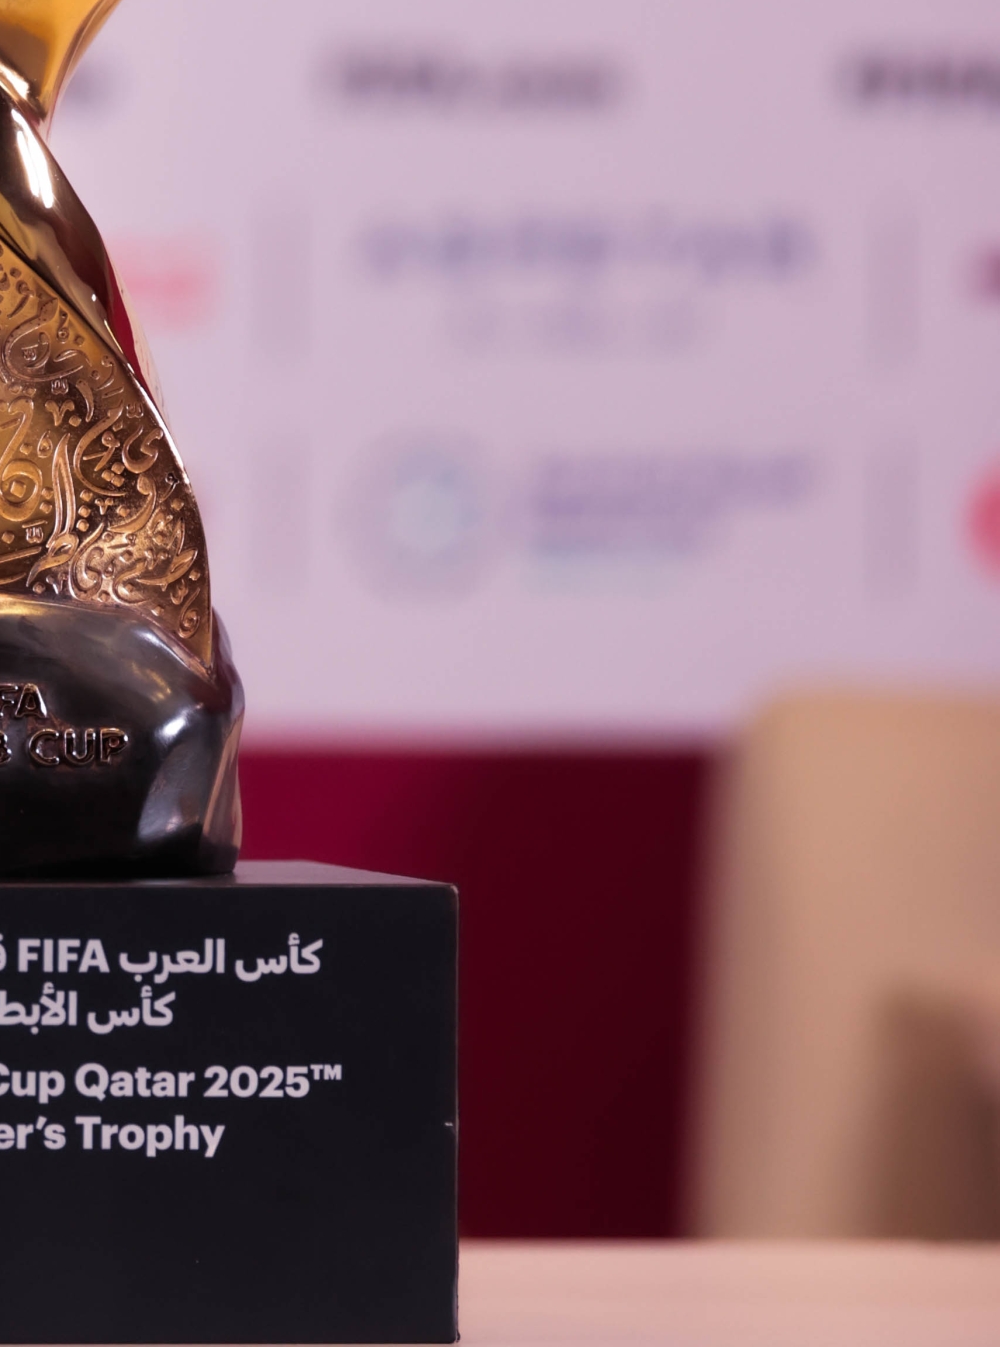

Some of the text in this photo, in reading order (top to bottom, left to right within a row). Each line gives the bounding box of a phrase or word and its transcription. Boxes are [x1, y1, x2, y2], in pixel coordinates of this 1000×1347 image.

[28, 728, 129, 766] CUP
[18, 938, 110, 973] FIFA
[119, 938, 225, 983] العرب
[235, 933, 323, 981] كأس
[88, 985, 175, 1034] كأس
[74, 1062, 195, 1101] Qatar
[75, 1115, 226, 1157] Trophy
